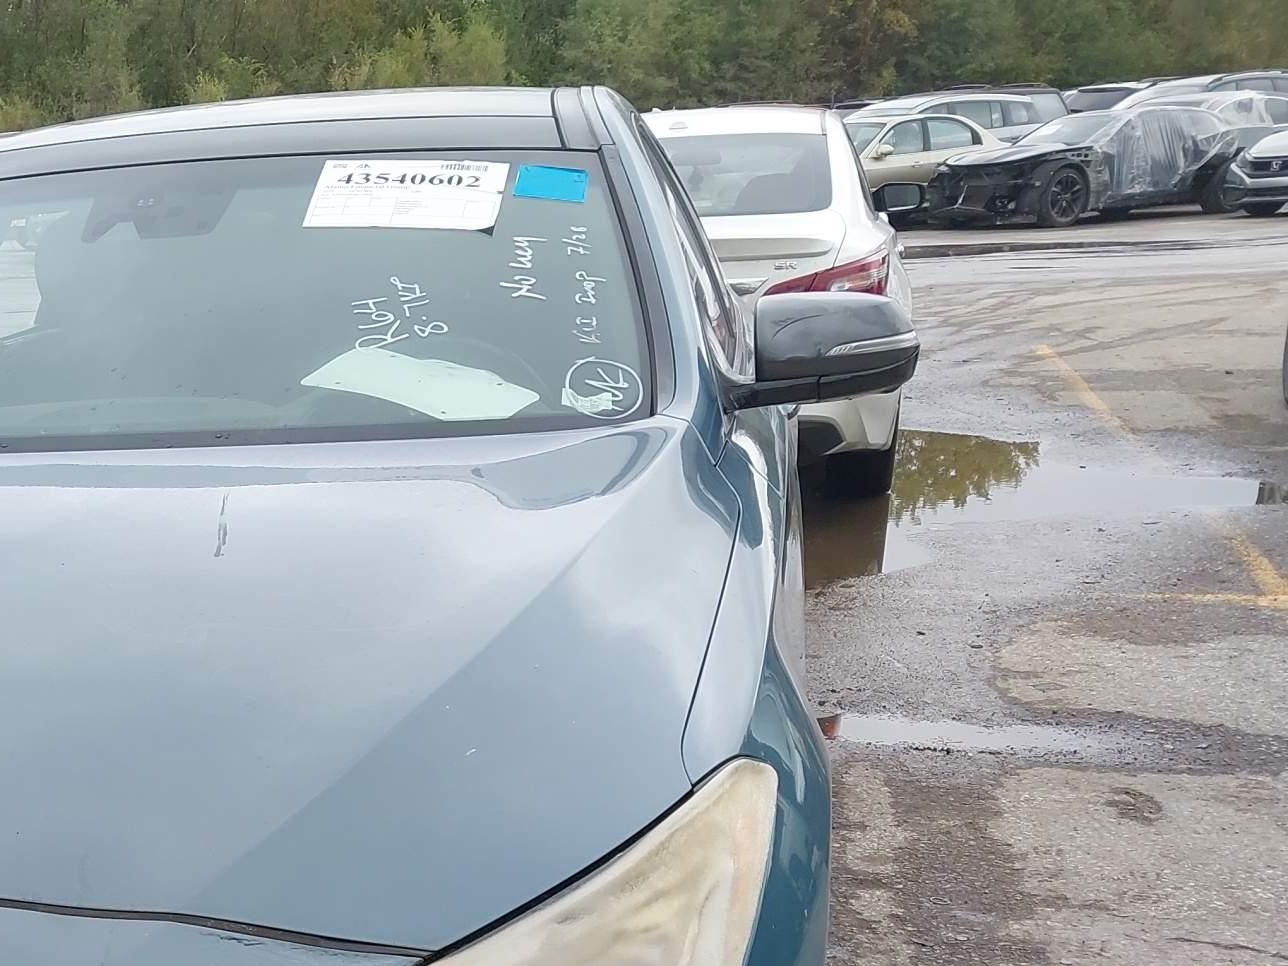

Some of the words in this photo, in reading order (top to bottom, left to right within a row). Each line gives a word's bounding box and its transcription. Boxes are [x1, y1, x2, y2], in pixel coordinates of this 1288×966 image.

[336, 172, 482, 188] 43540602
[774, 261, 798, 271] SR
[351, 296, 410, 351] R64
